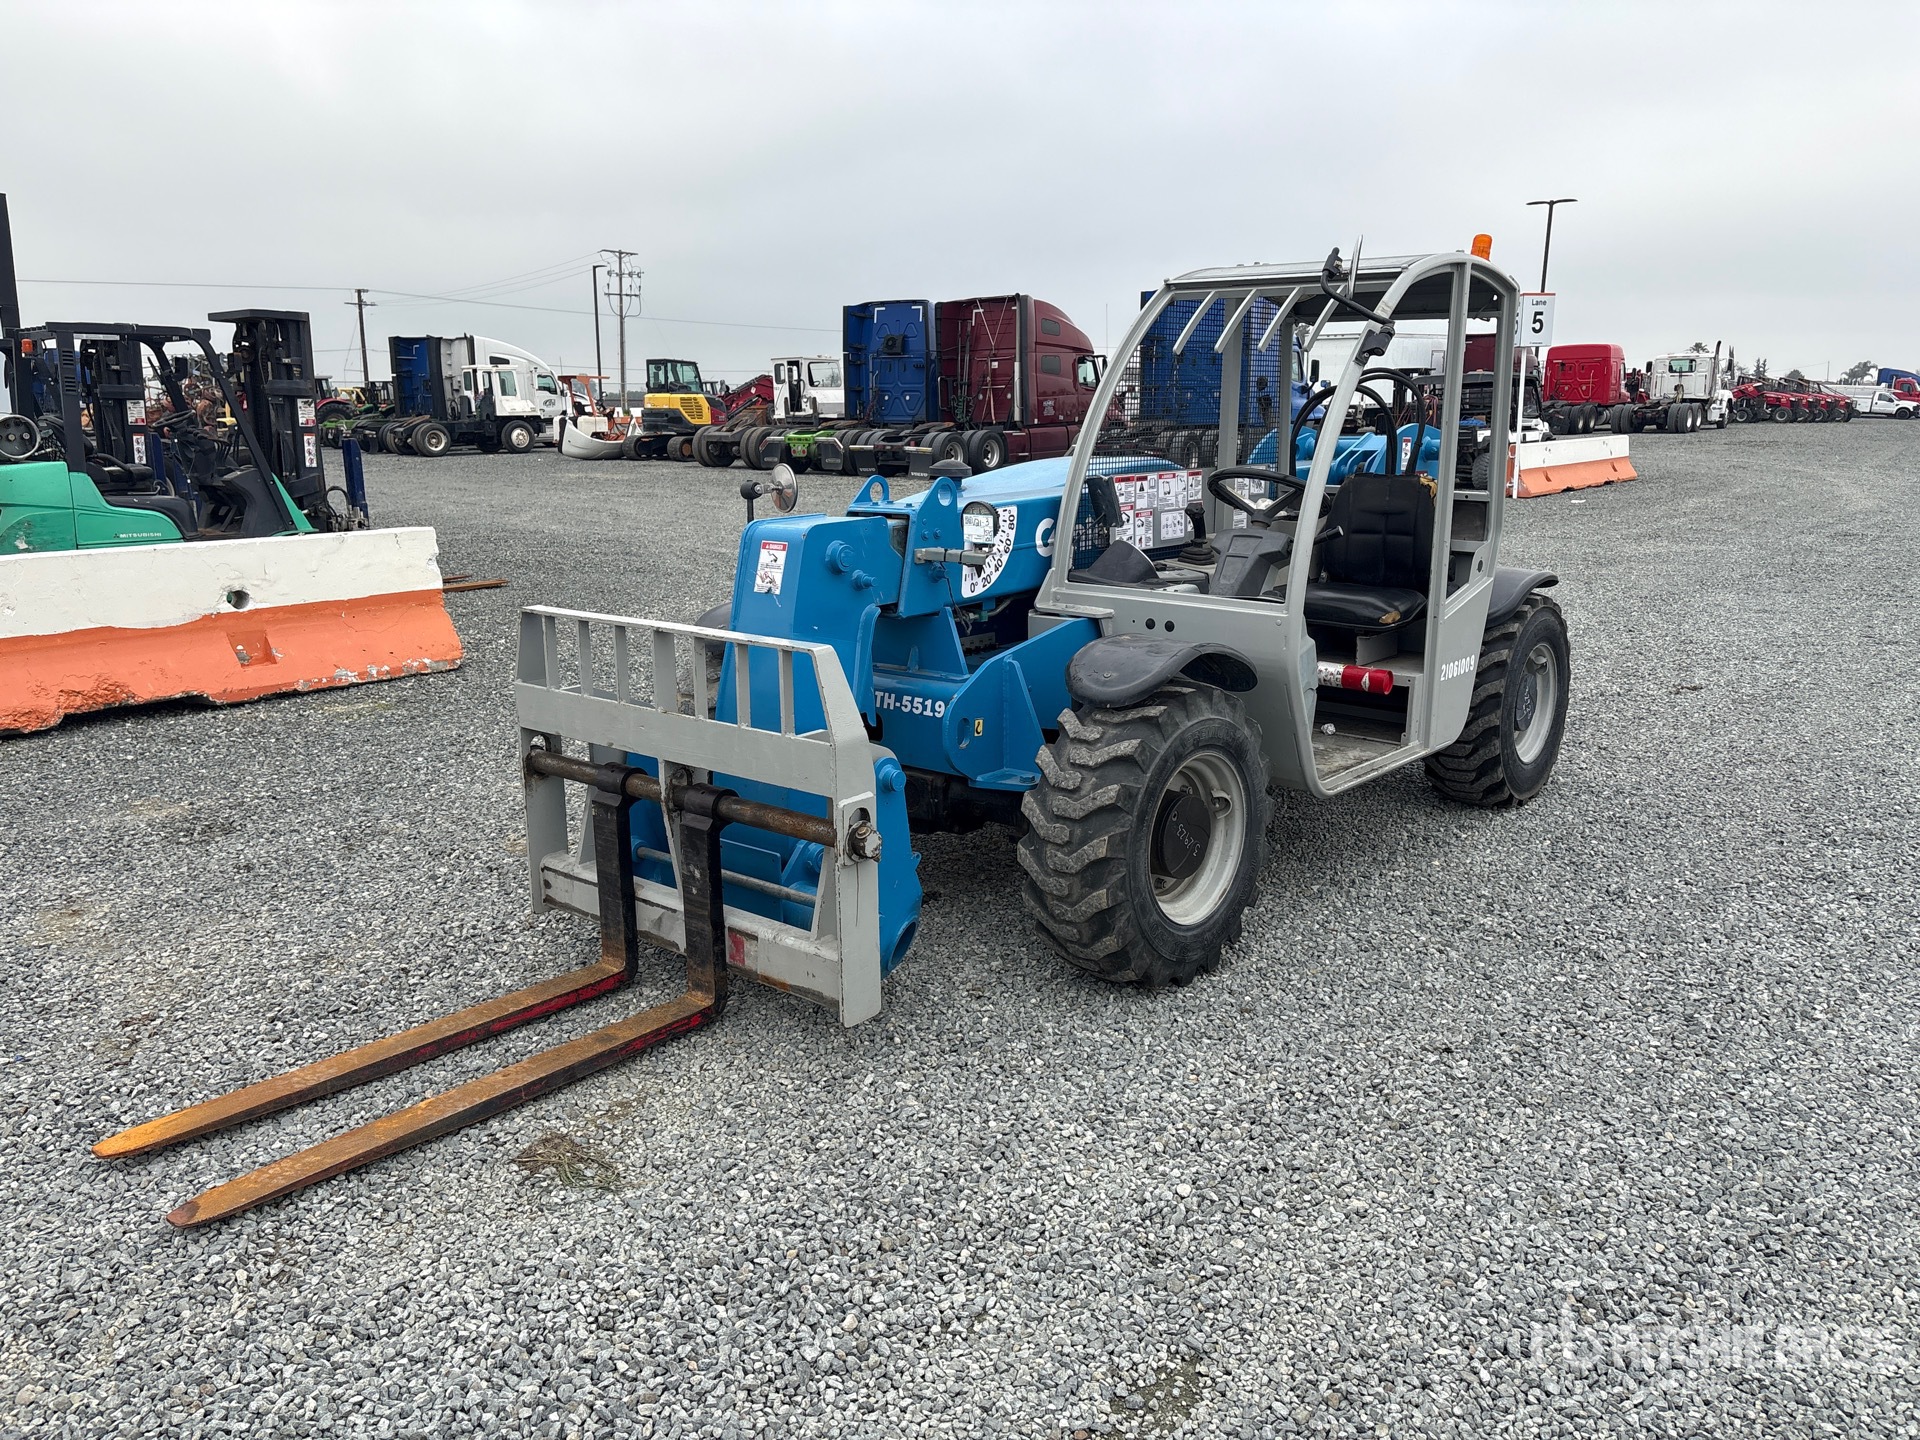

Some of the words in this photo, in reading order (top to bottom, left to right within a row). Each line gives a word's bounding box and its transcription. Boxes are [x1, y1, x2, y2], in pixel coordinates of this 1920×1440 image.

[1531, 311, 1544, 334] 5
[1440, 654, 1475, 681] 21061009
[875, 691, 945, 718] TH-5519
